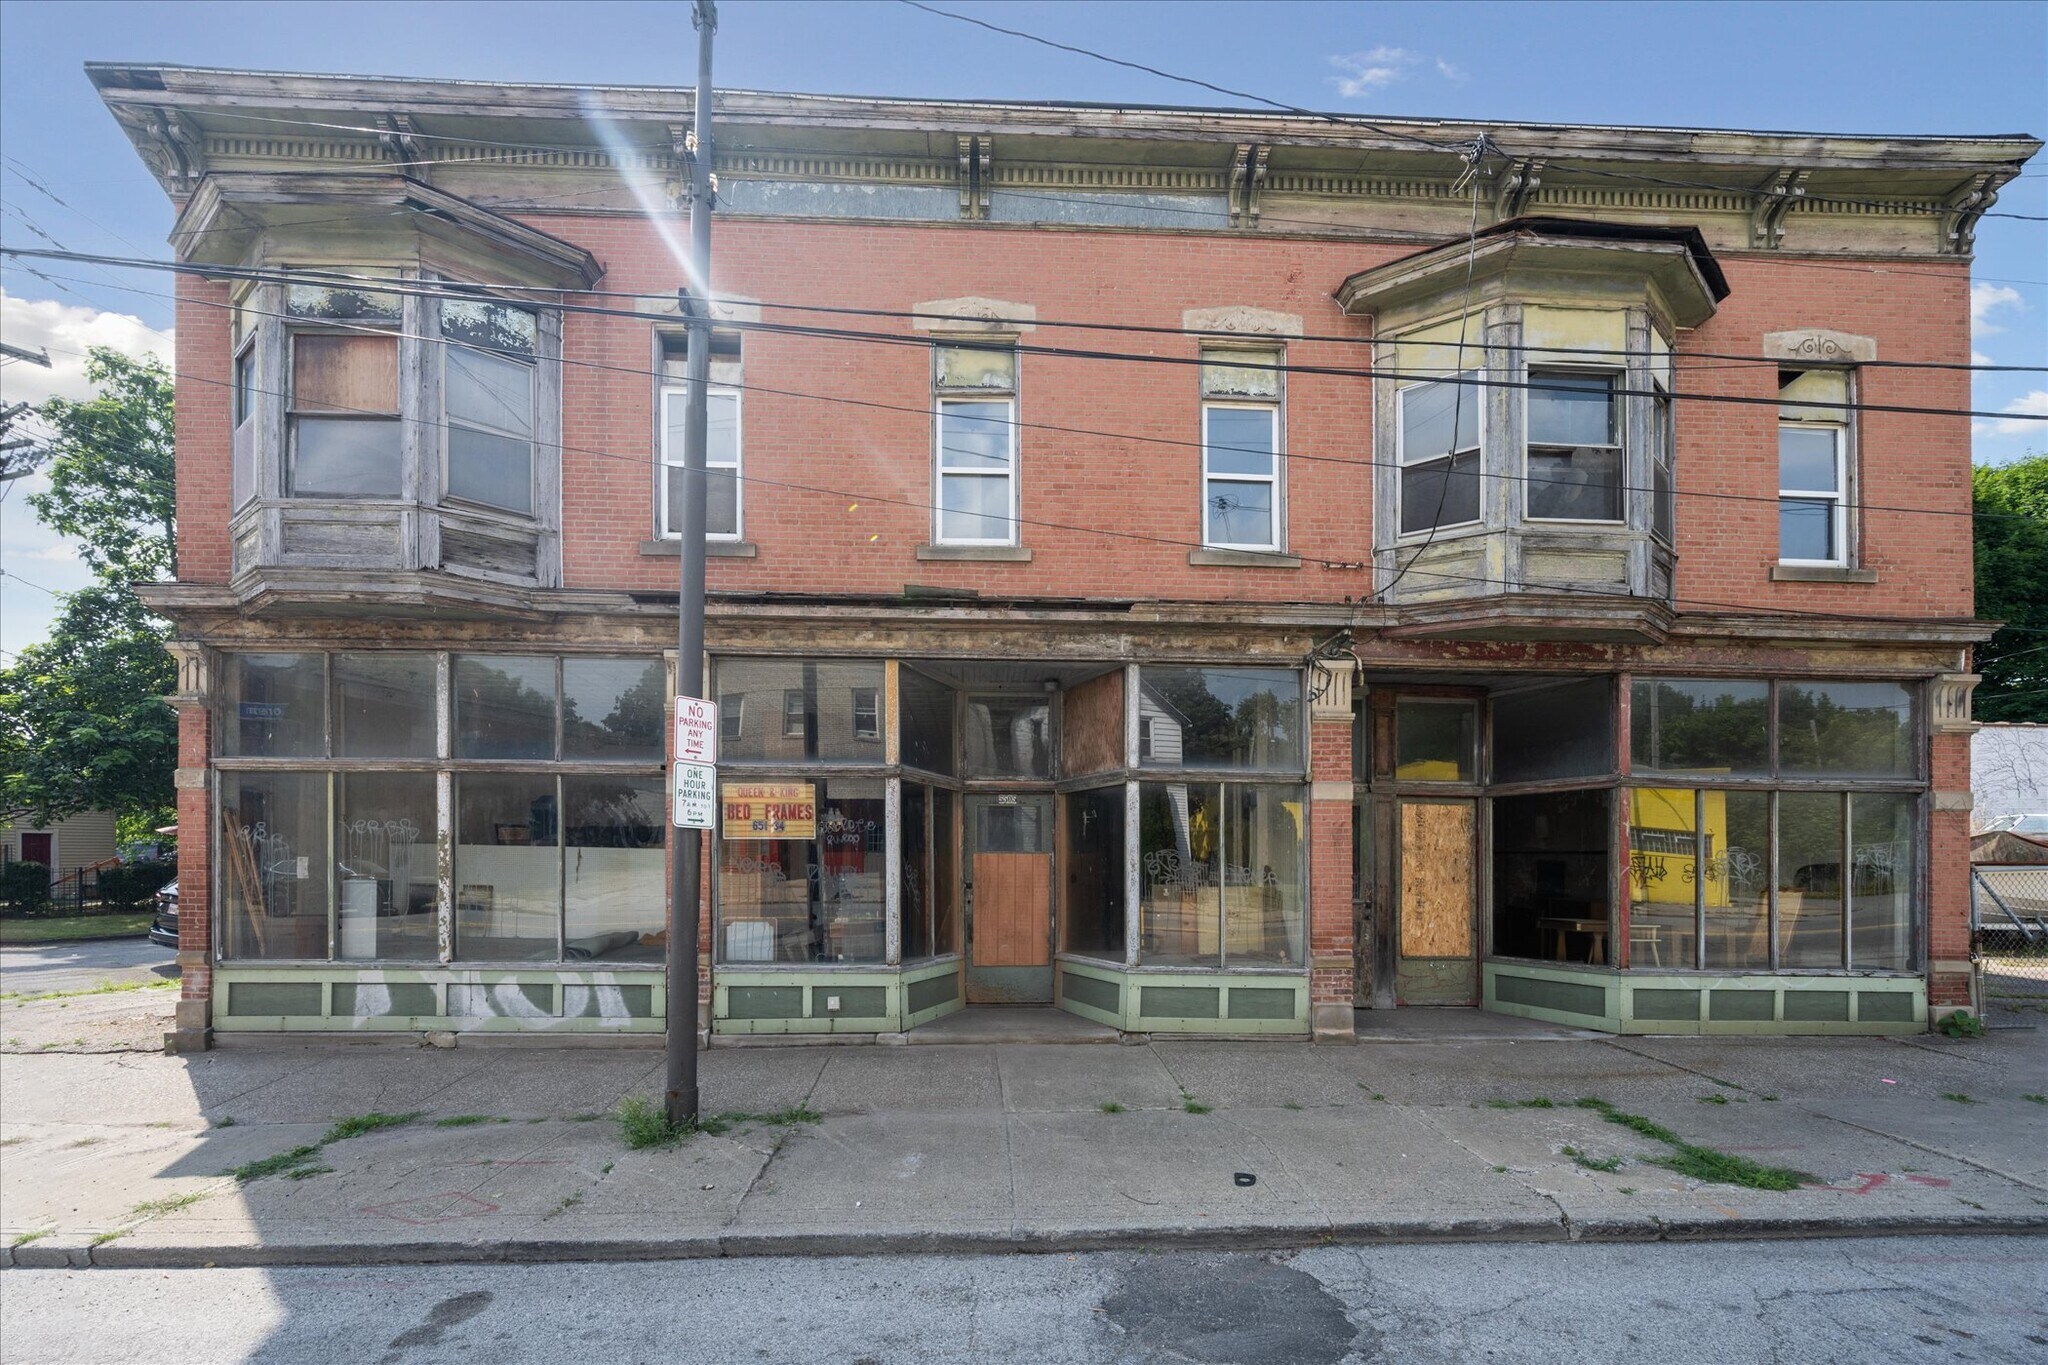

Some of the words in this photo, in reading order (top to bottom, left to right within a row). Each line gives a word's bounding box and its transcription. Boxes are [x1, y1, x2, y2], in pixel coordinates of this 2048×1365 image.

[688, 705, 704, 719] NO
[679, 717, 712, 731] PARKING
[687, 729, 704, 739] ANY
[686, 738, 704, 749] TIME
[687, 769, 703, 780] ONE
[683, 779, 706, 790] HOUR
[678, 789, 711, 801] PARKING
[737, 787, 764, 798] QUEEN
[769, 787, 775, 797] &
[781, 787, 799, 798] KING
[727, 803, 751, 820] BED
[765, 803, 812, 820] FRAMES
